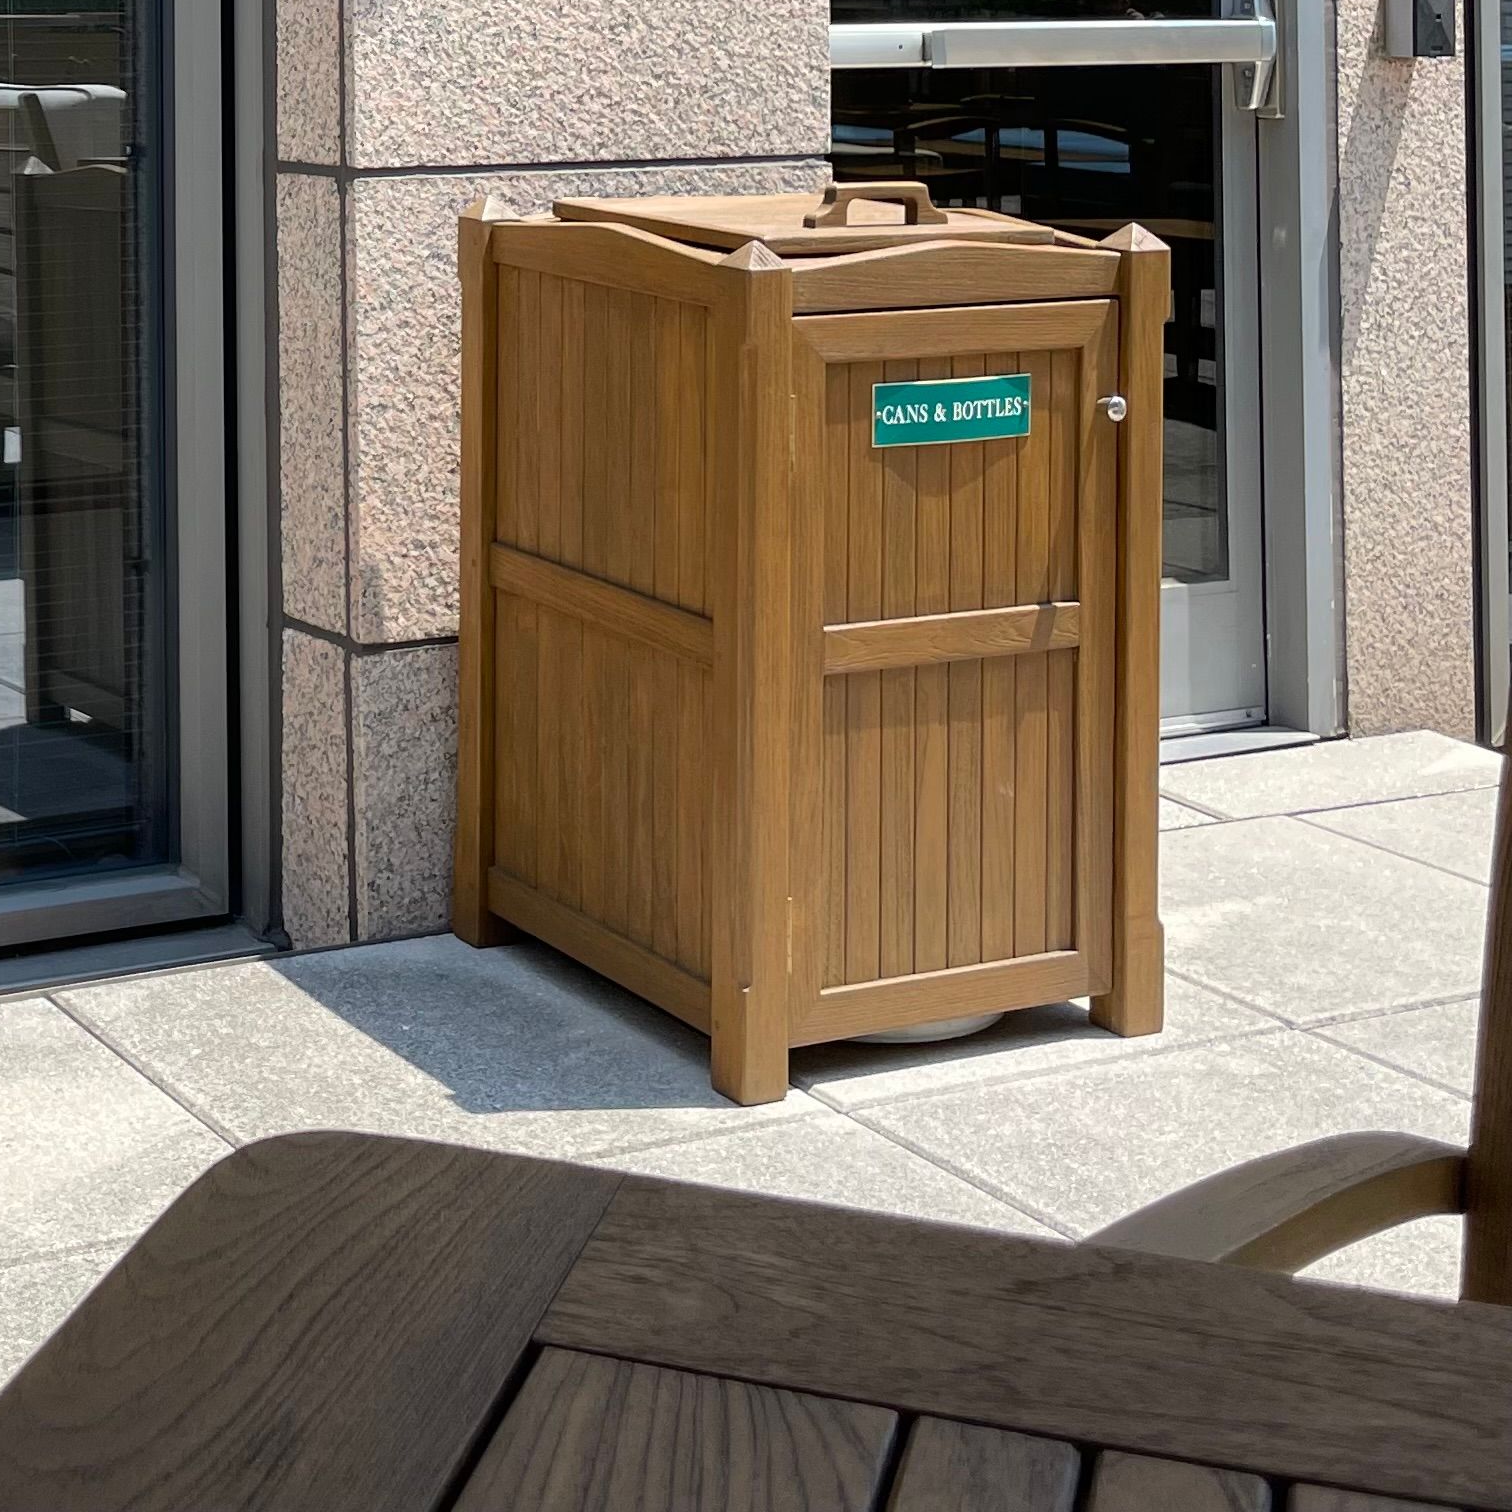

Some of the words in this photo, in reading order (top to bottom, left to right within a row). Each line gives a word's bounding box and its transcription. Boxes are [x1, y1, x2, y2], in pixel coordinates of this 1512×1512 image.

[882, 404, 929, 425] CANS
[933, 402, 947, 423] &
[952, 396, 1022, 421] BOTTLES
